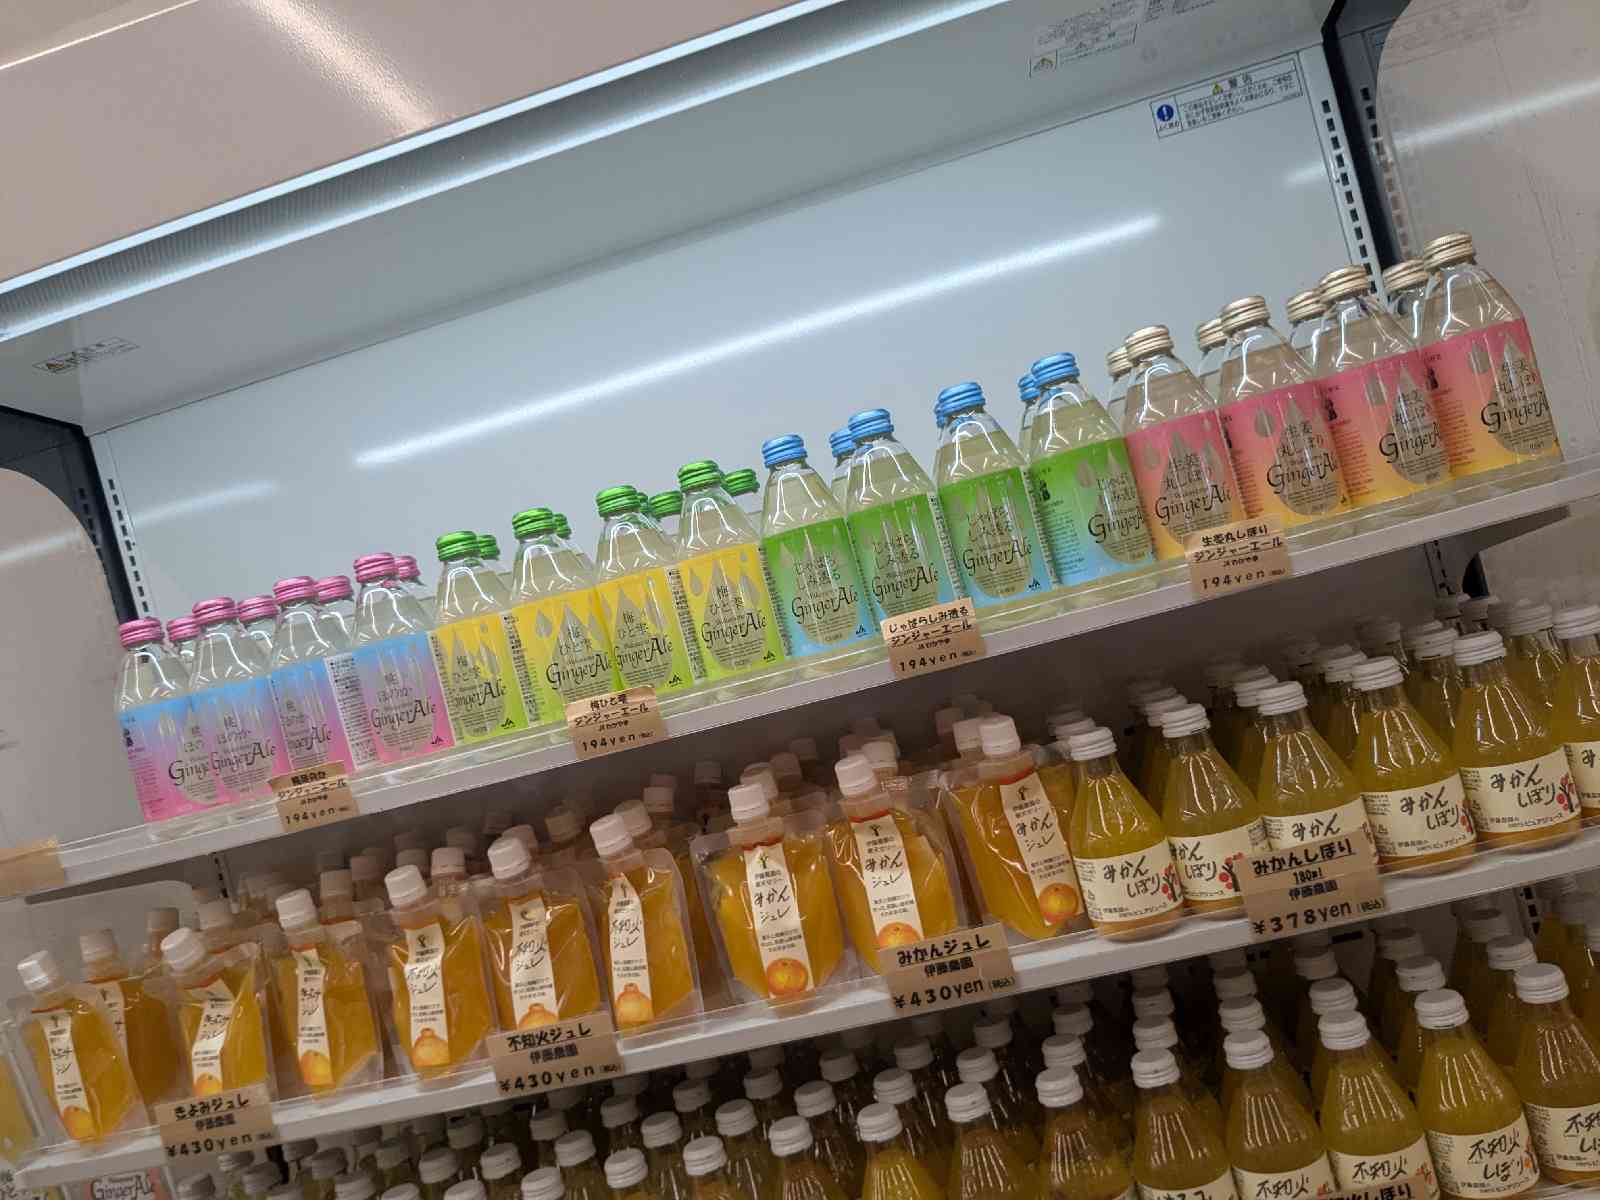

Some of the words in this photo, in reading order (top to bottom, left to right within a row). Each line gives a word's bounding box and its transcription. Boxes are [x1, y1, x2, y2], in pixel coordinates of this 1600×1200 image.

[1252, 838, 1353, 875] みかんしぼり
[897, 934, 991, 965] みかんジュレ
[506, 1023, 591, 1051] 不知火ジュレ
